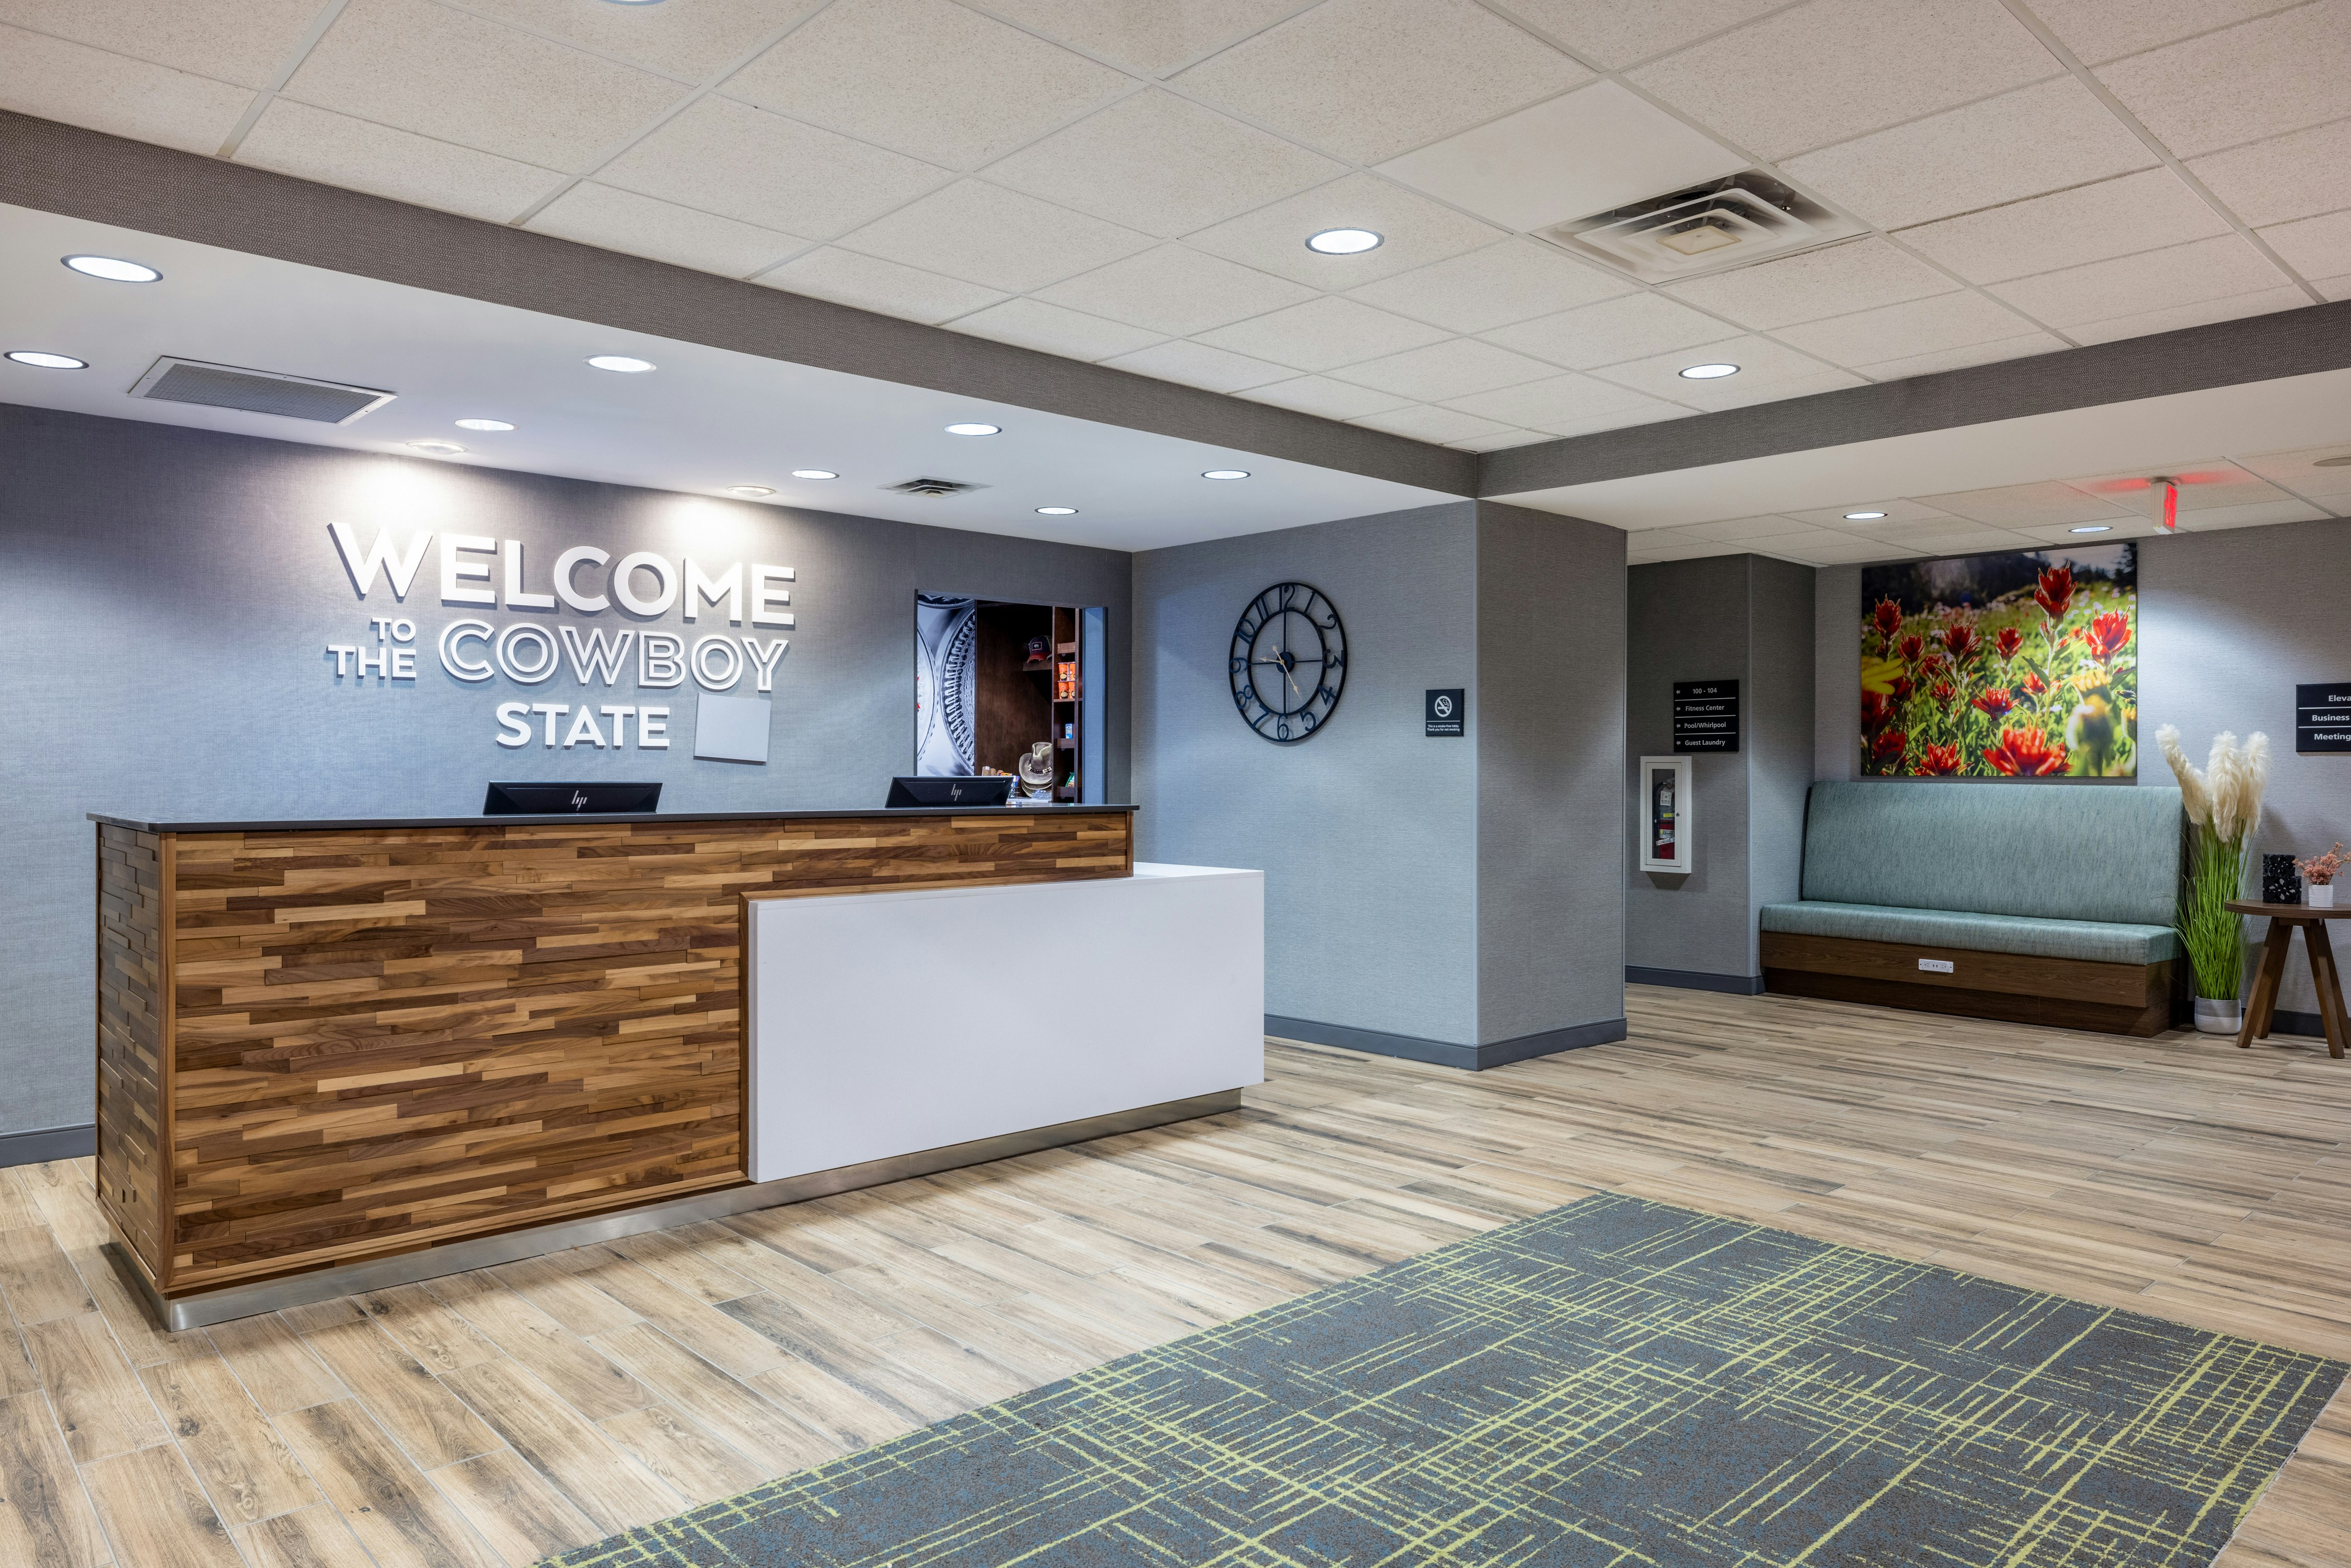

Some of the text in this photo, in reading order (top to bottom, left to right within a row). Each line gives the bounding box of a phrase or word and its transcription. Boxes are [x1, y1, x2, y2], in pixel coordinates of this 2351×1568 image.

[328, 523, 795, 625] WELCOME
[1278, 584, 1295, 612] 12
[1304, 590, 1317, 615] 1
[372, 617, 417, 642] TO
[1235, 618, 1255, 645] 10
[1316, 614, 1338, 639] 2
[327, 644, 417, 681] THE
[438, 619, 789, 691] COWBOY
[1322, 649, 1346, 668] 3
[1235, 684, 1254, 709] 8
[1317, 684, 1336, 706] 4
[495, 702, 671, 747] STATE
[1252, 704, 1271, 729] 7
[1277, 714, 1289, 742] 6
[1299, 708, 1317, 732] 5
